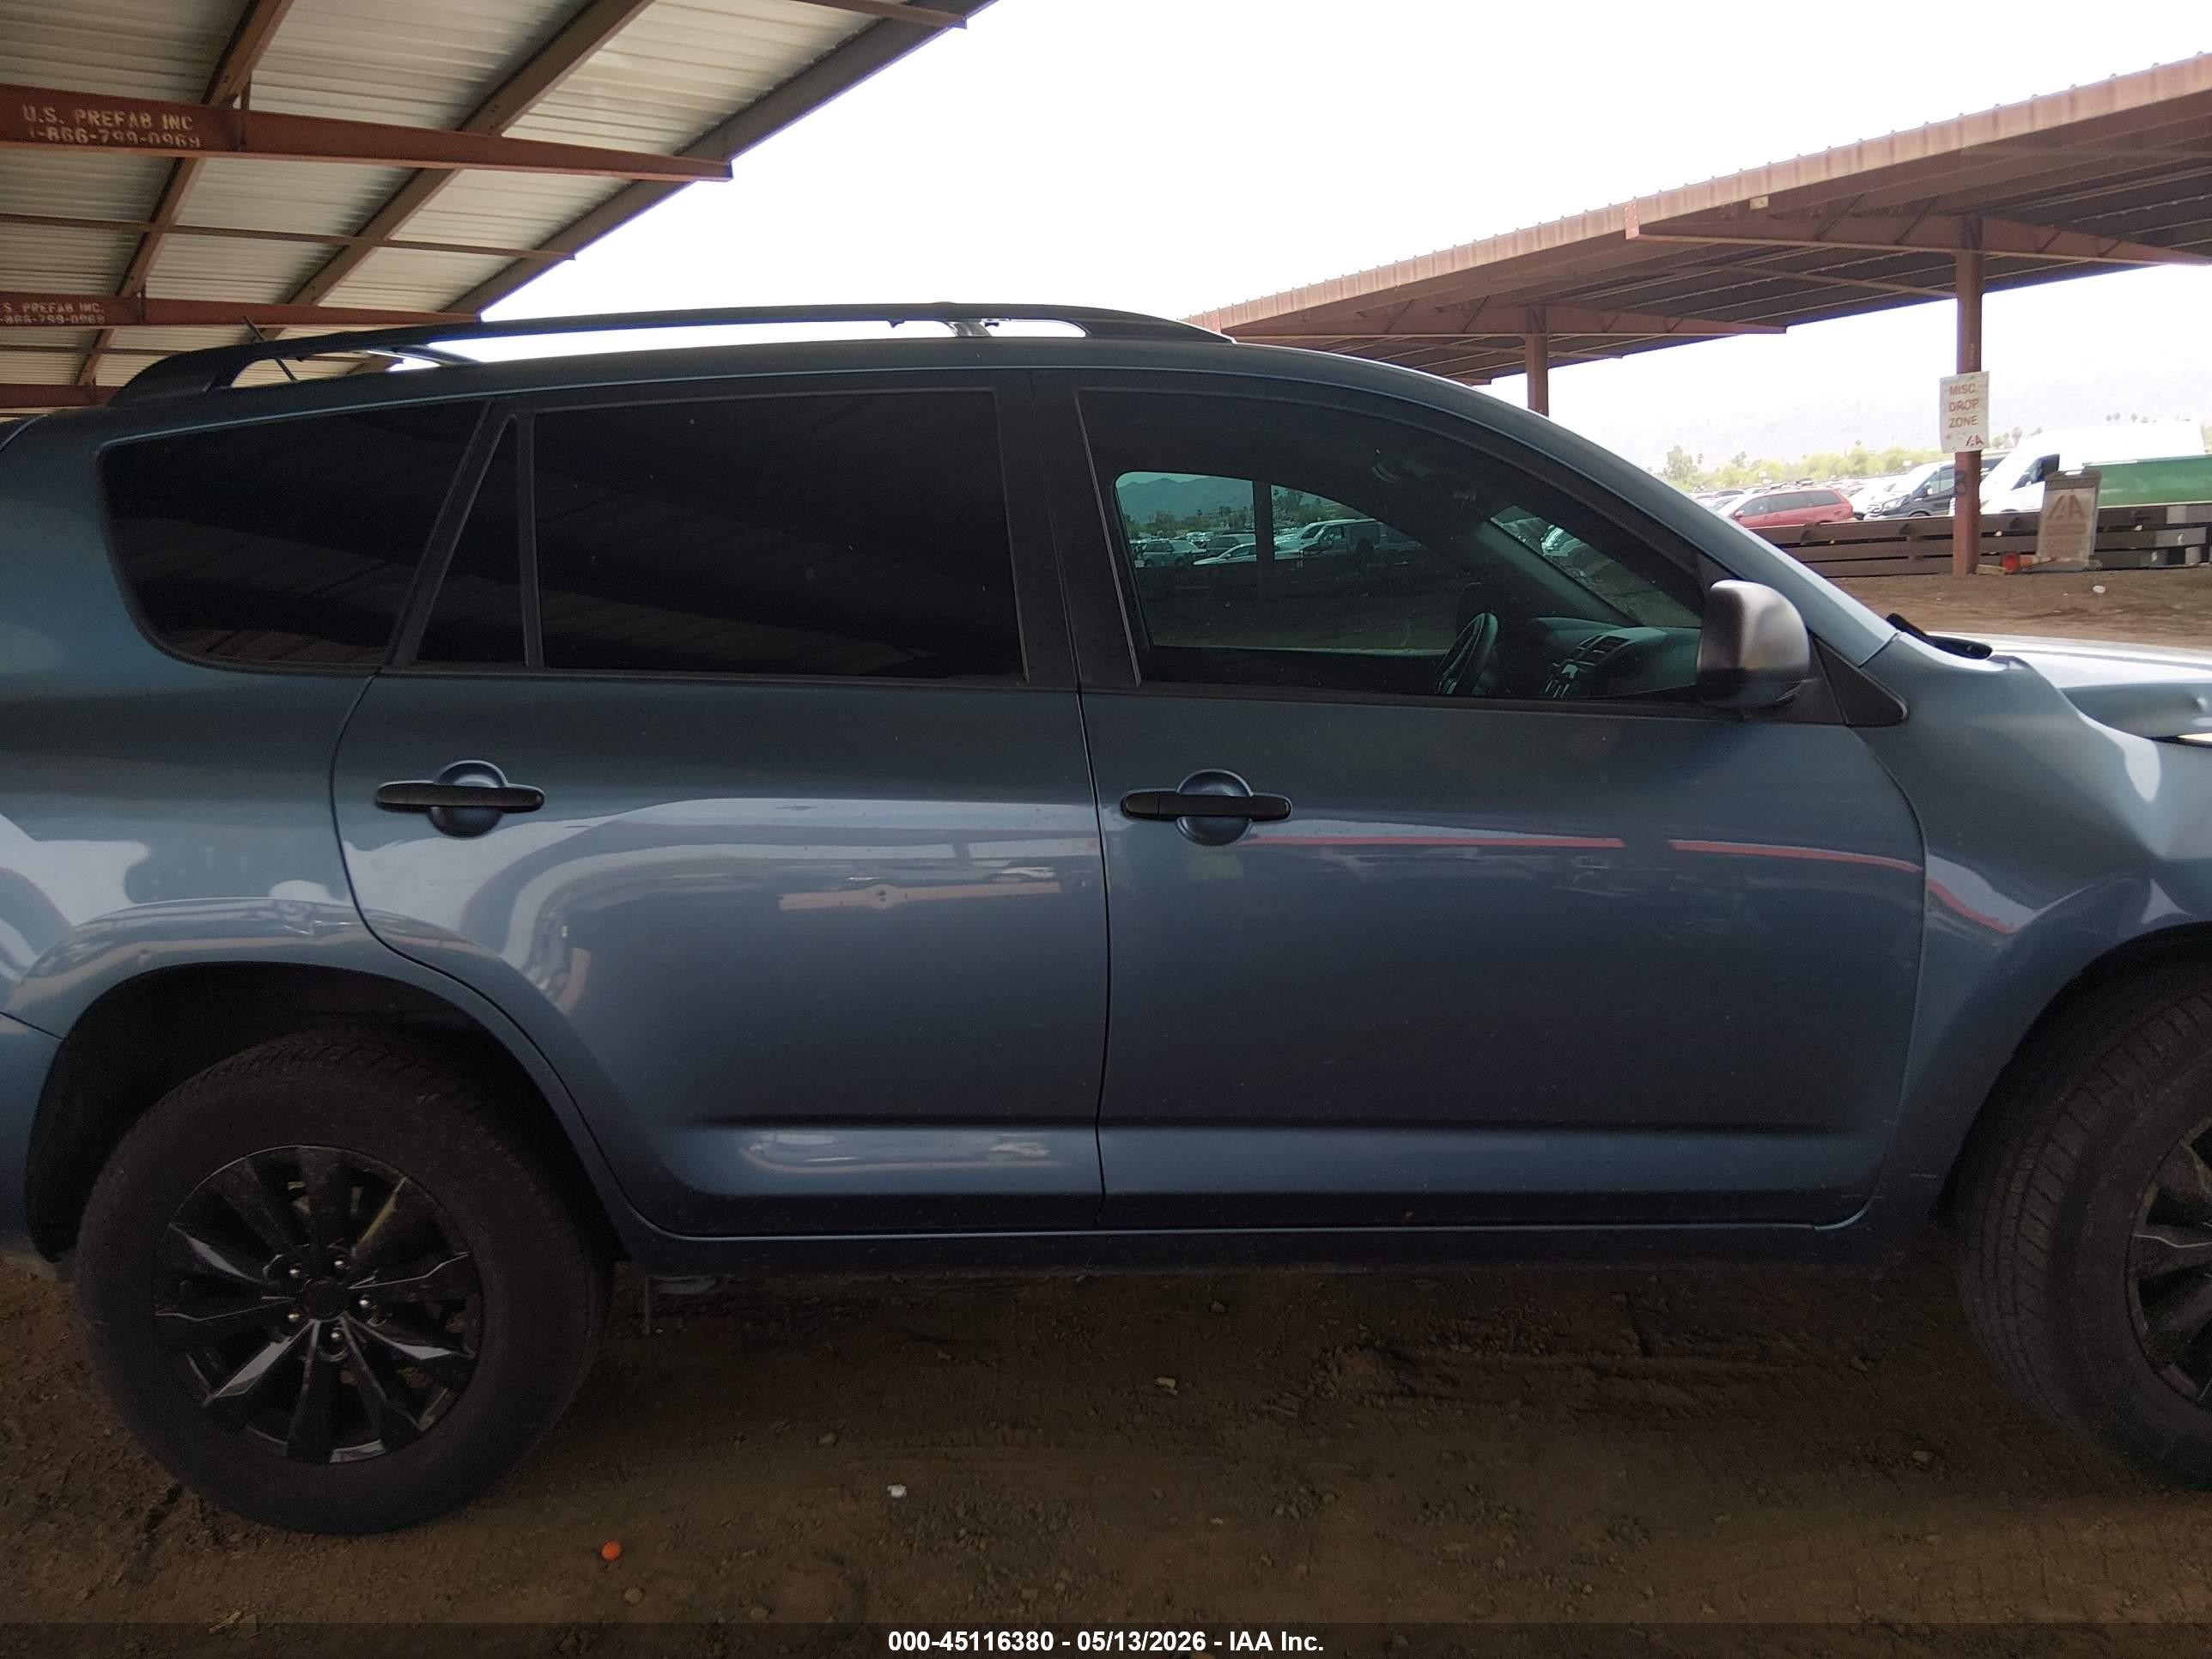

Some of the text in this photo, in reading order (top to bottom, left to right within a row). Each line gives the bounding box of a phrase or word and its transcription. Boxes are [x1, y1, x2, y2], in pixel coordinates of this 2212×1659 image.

[23, 105, 65, 125] U.S.
[75, 108, 153, 129] PREFAB
[1948, 398, 1979, 412] DROP
[1948, 415, 1978, 428] ZONE
